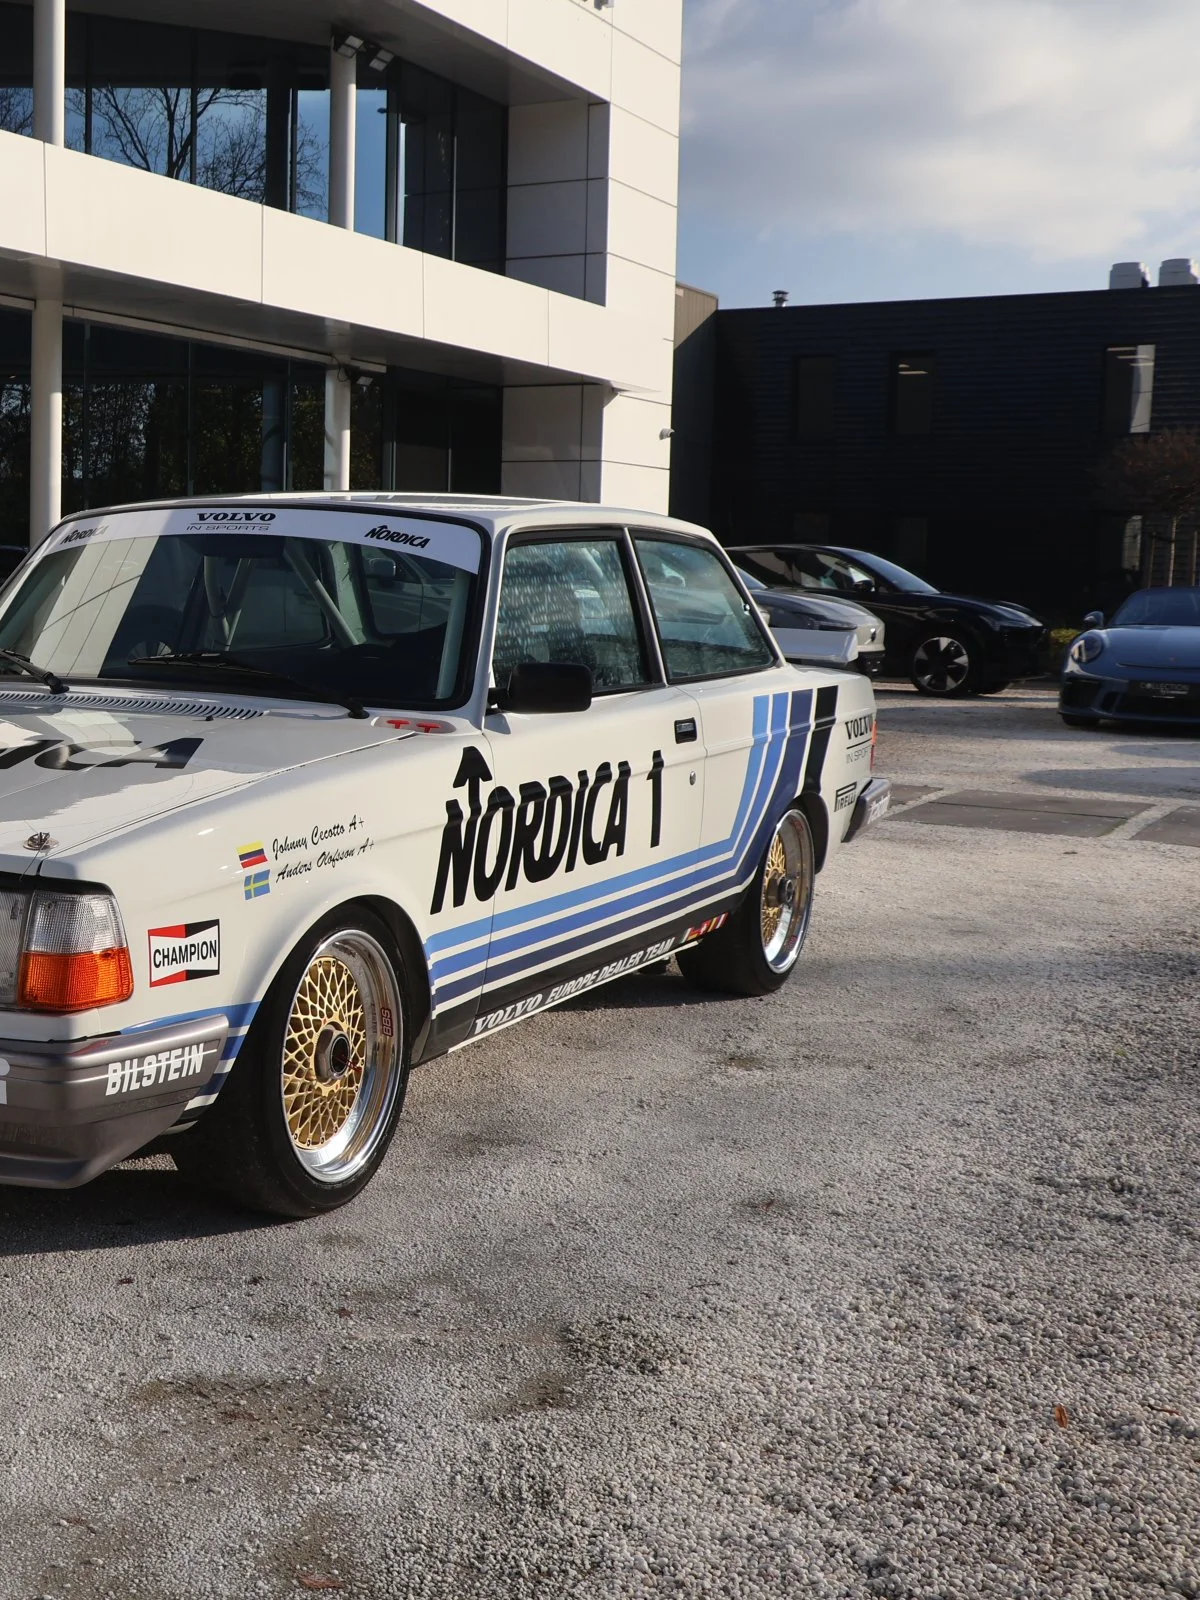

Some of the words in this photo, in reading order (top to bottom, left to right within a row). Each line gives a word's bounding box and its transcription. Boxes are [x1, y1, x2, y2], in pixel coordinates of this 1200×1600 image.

[196, 513, 276, 521] VOLVO
[60, 525, 109, 544] NORDICA
[364, 525, 431, 548] NORDICA
[272, 834, 308, 861] Johnny
[311, 824, 345, 845] Cecotto
[430, 746, 631, 915] NORDICA
[646, 750, 664, 848] 1
[275, 861, 312, 883] Anders
[316, 847, 355, 869] Olofsson
[153, 940, 217, 968] CHAMPION
[473, 994, 543, 1035] VOLVO
[545, 969, 599, 1004] EUROPE
[596, 954, 642, 982] DEALER
[642, 937, 676, 963] TEAM
[381, 1008, 393, 1037] BBS
[105, 1043, 203, 1096] BILSTEIN
